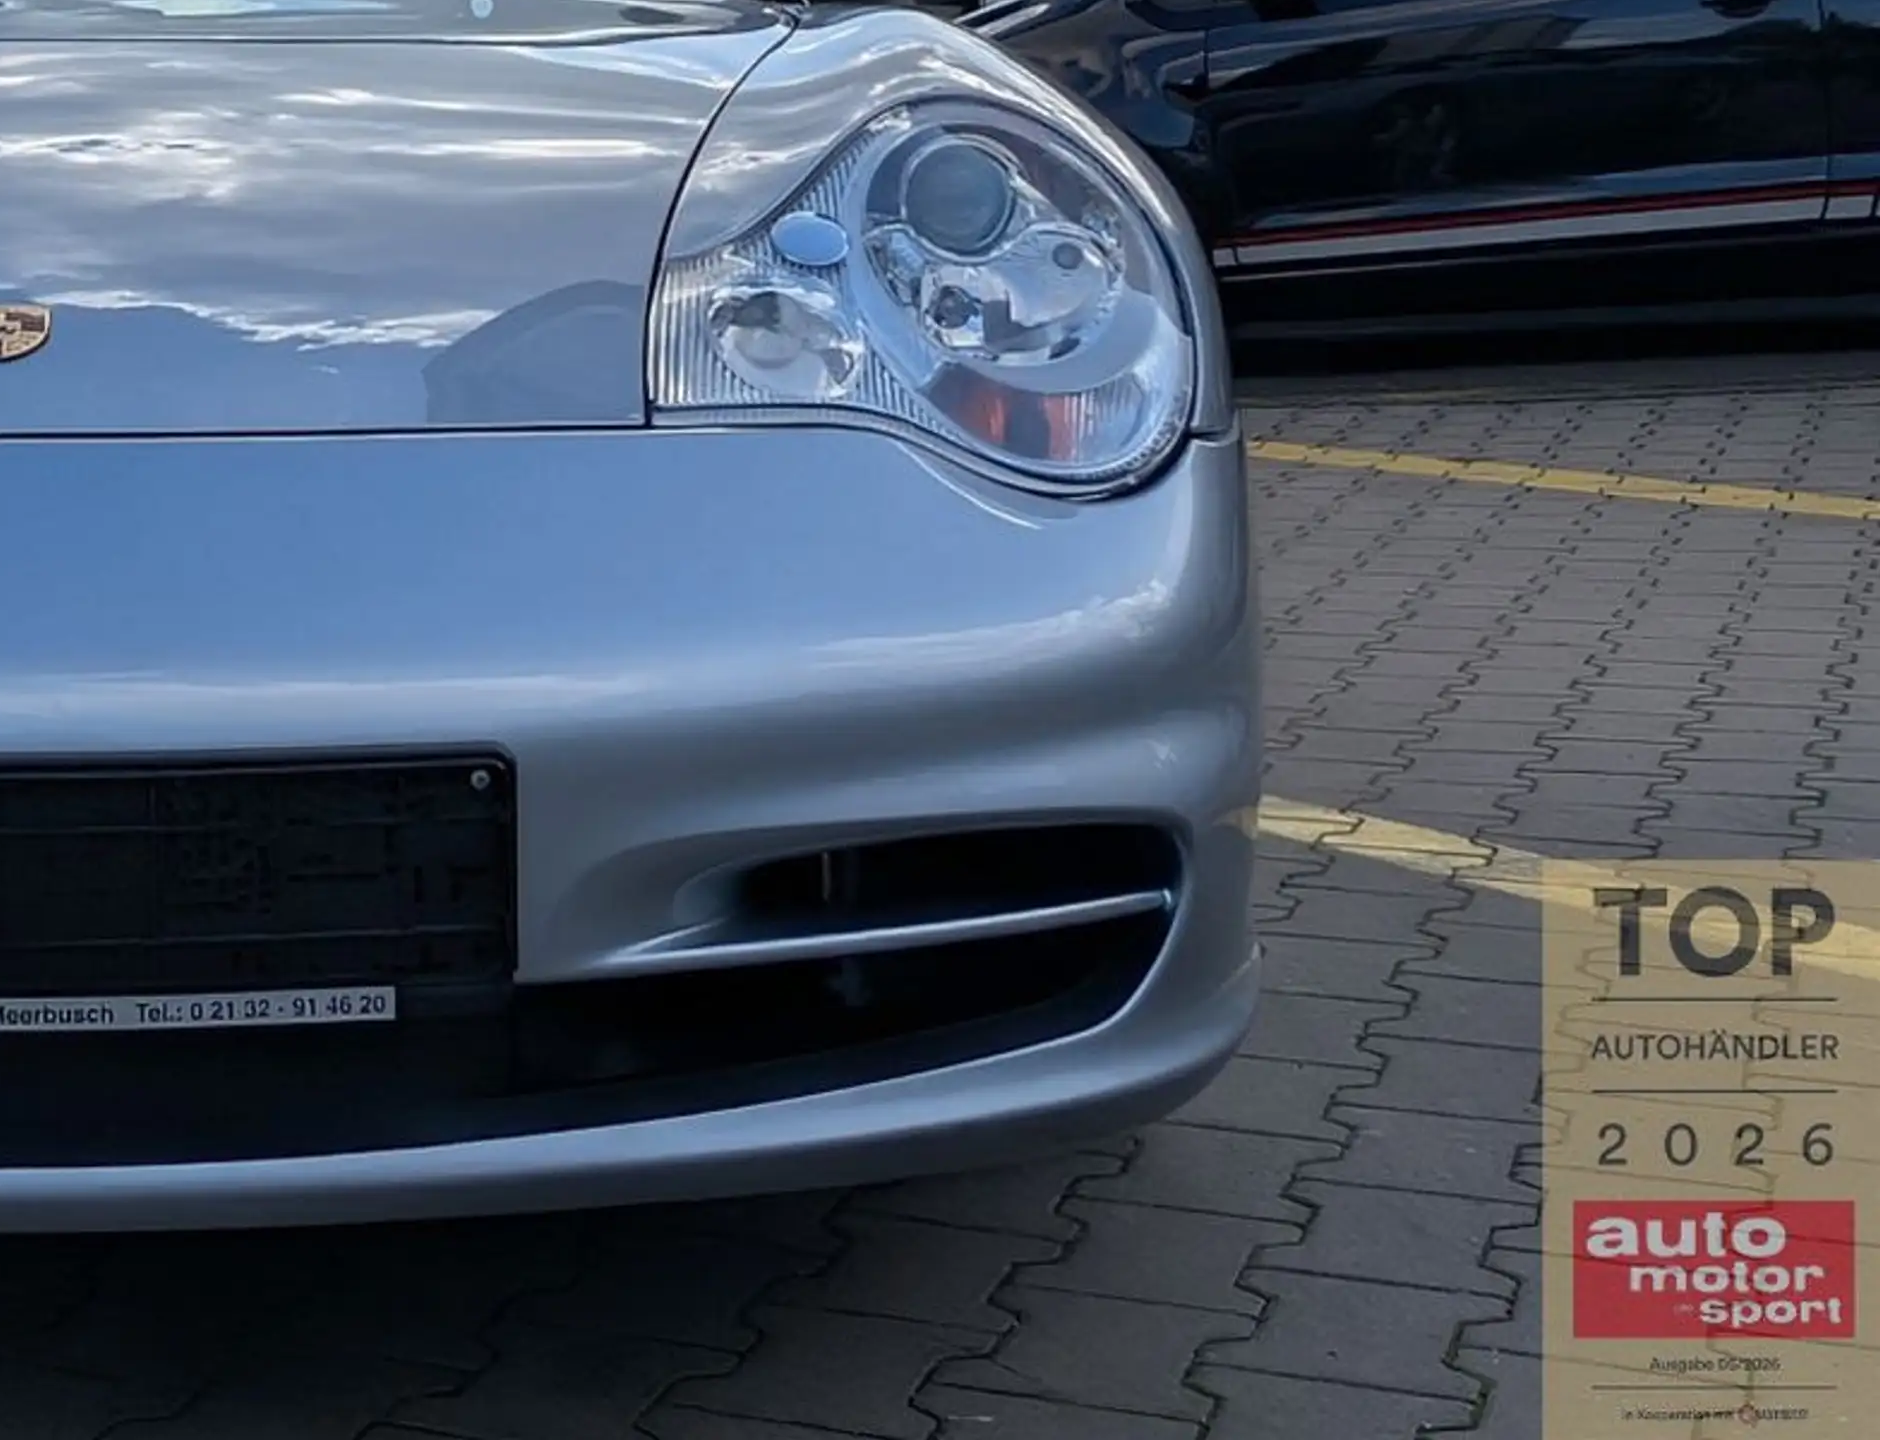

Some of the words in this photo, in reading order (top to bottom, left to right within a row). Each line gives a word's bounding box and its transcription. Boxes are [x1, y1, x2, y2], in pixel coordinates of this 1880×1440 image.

[209, 1000, 235, 1021] 21
[291, 998, 317, 1018] 91
[359, 995, 386, 1014] 20
